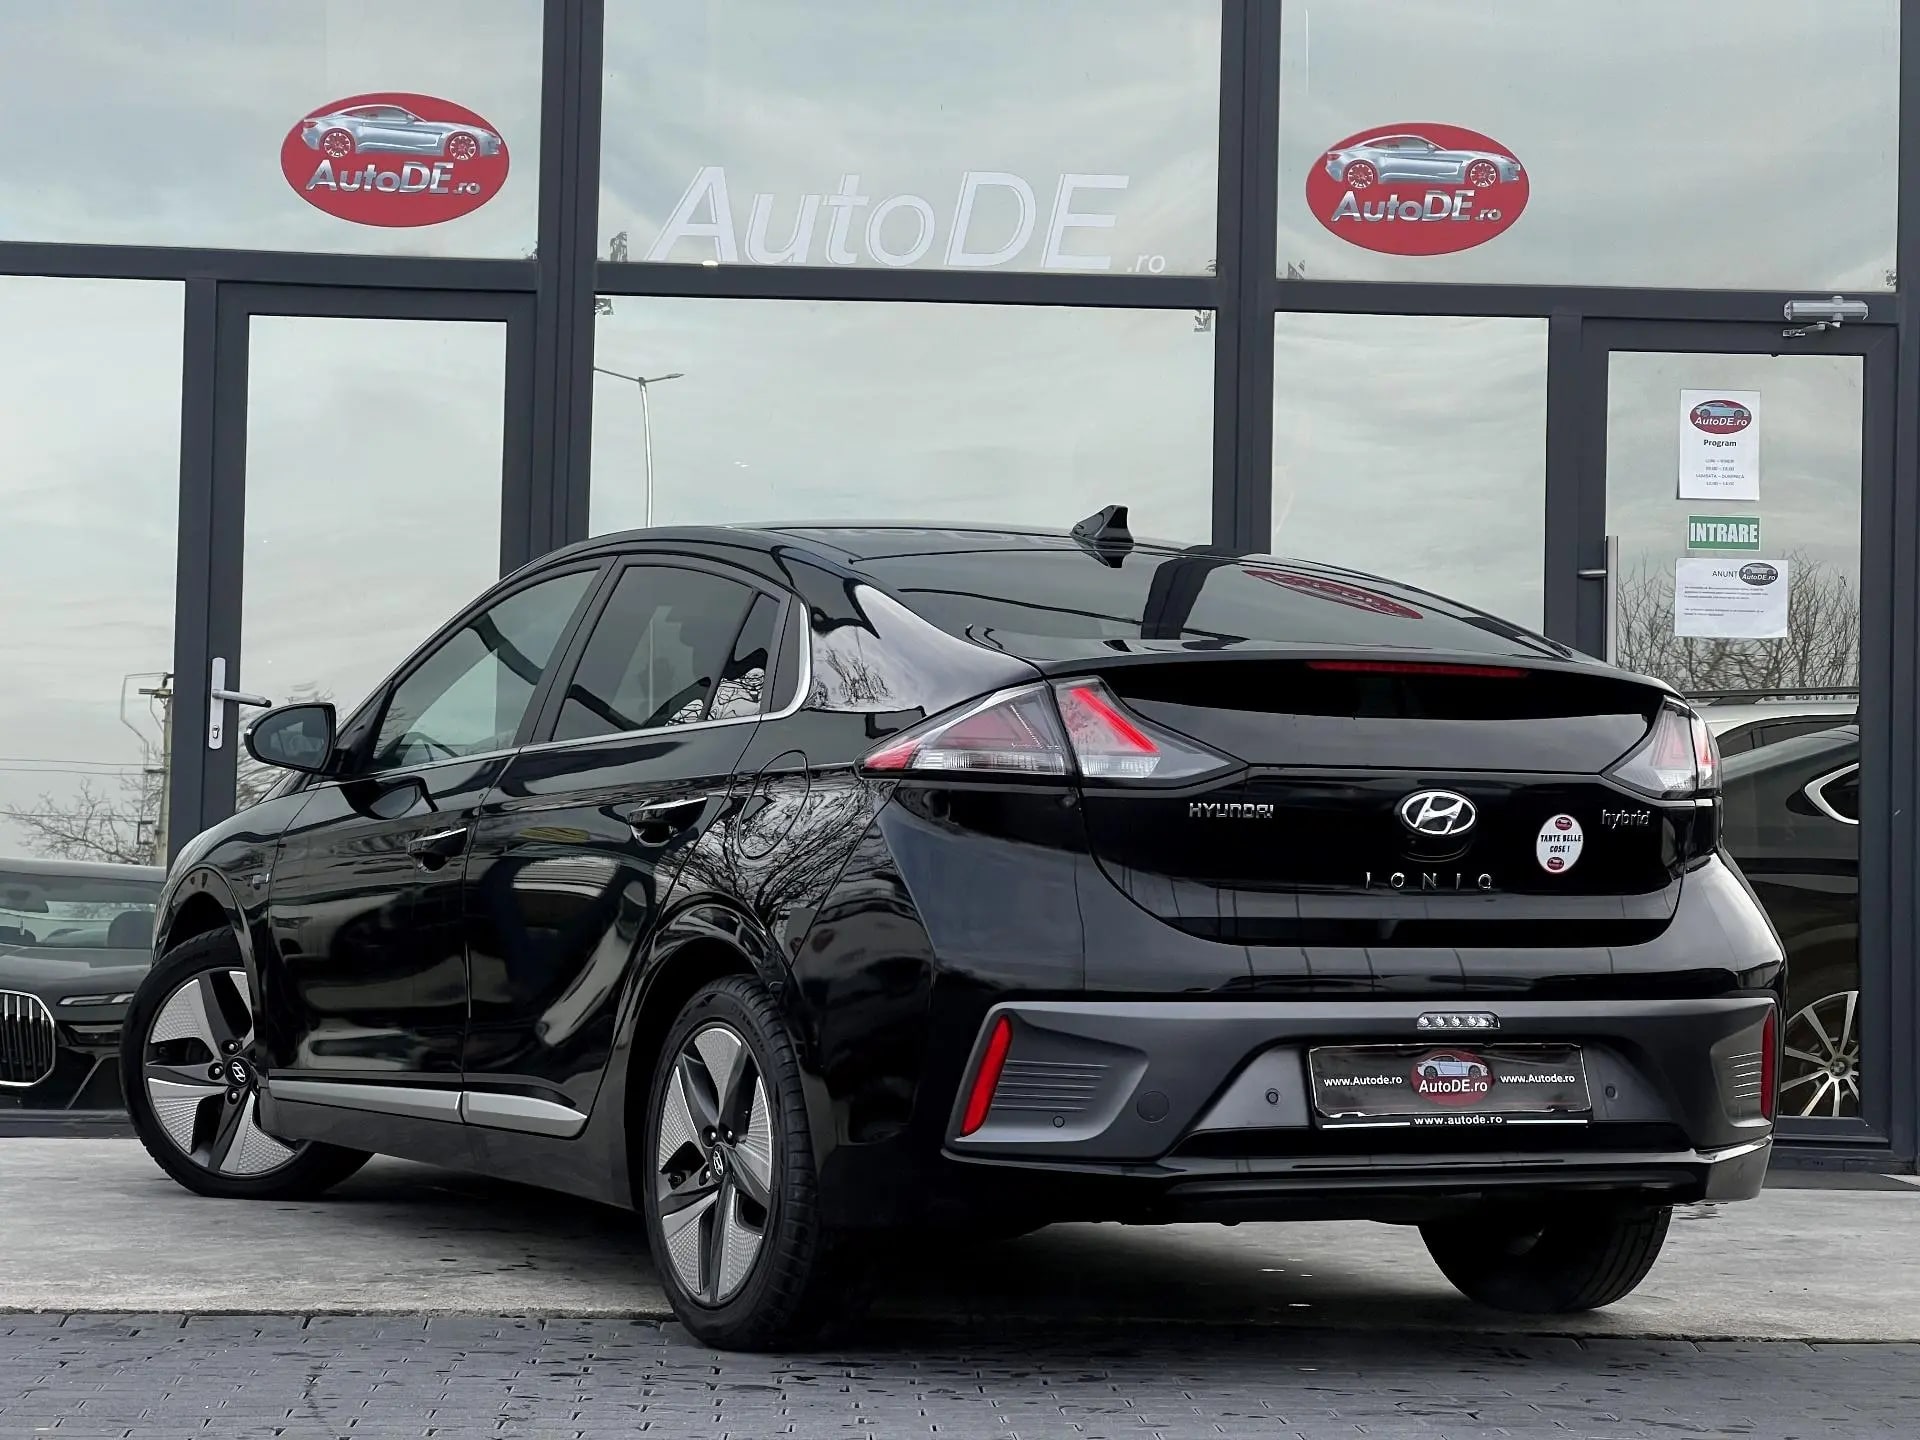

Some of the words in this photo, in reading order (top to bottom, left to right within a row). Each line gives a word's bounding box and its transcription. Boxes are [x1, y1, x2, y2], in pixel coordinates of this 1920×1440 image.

[1694, 416, 1748, 427] AutoDE.ro
[1703, 439, 1737, 448] Program
[1690, 522, 1758, 543] INTRARE
[1741, 573, 1776, 581] AutoDE.ro
[1188, 802, 1275, 819] HYUNDAI
[1601, 809, 1651, 830] hybrid
[1540, 834, 1560, 842] TANTE
[1562, 834, 1582, 842] BELLE
[1365, 871, 1493, 890] IONIQ
[1323, 1074, 1403, 1087] www.Autode.ro
[1500, 1073, 1576, 1084] www.Autode.ro
[1418, 1079, 1489, 1094] AutoDE.ro
[1413, 1114, 1503, 1126] www.autode.ro
